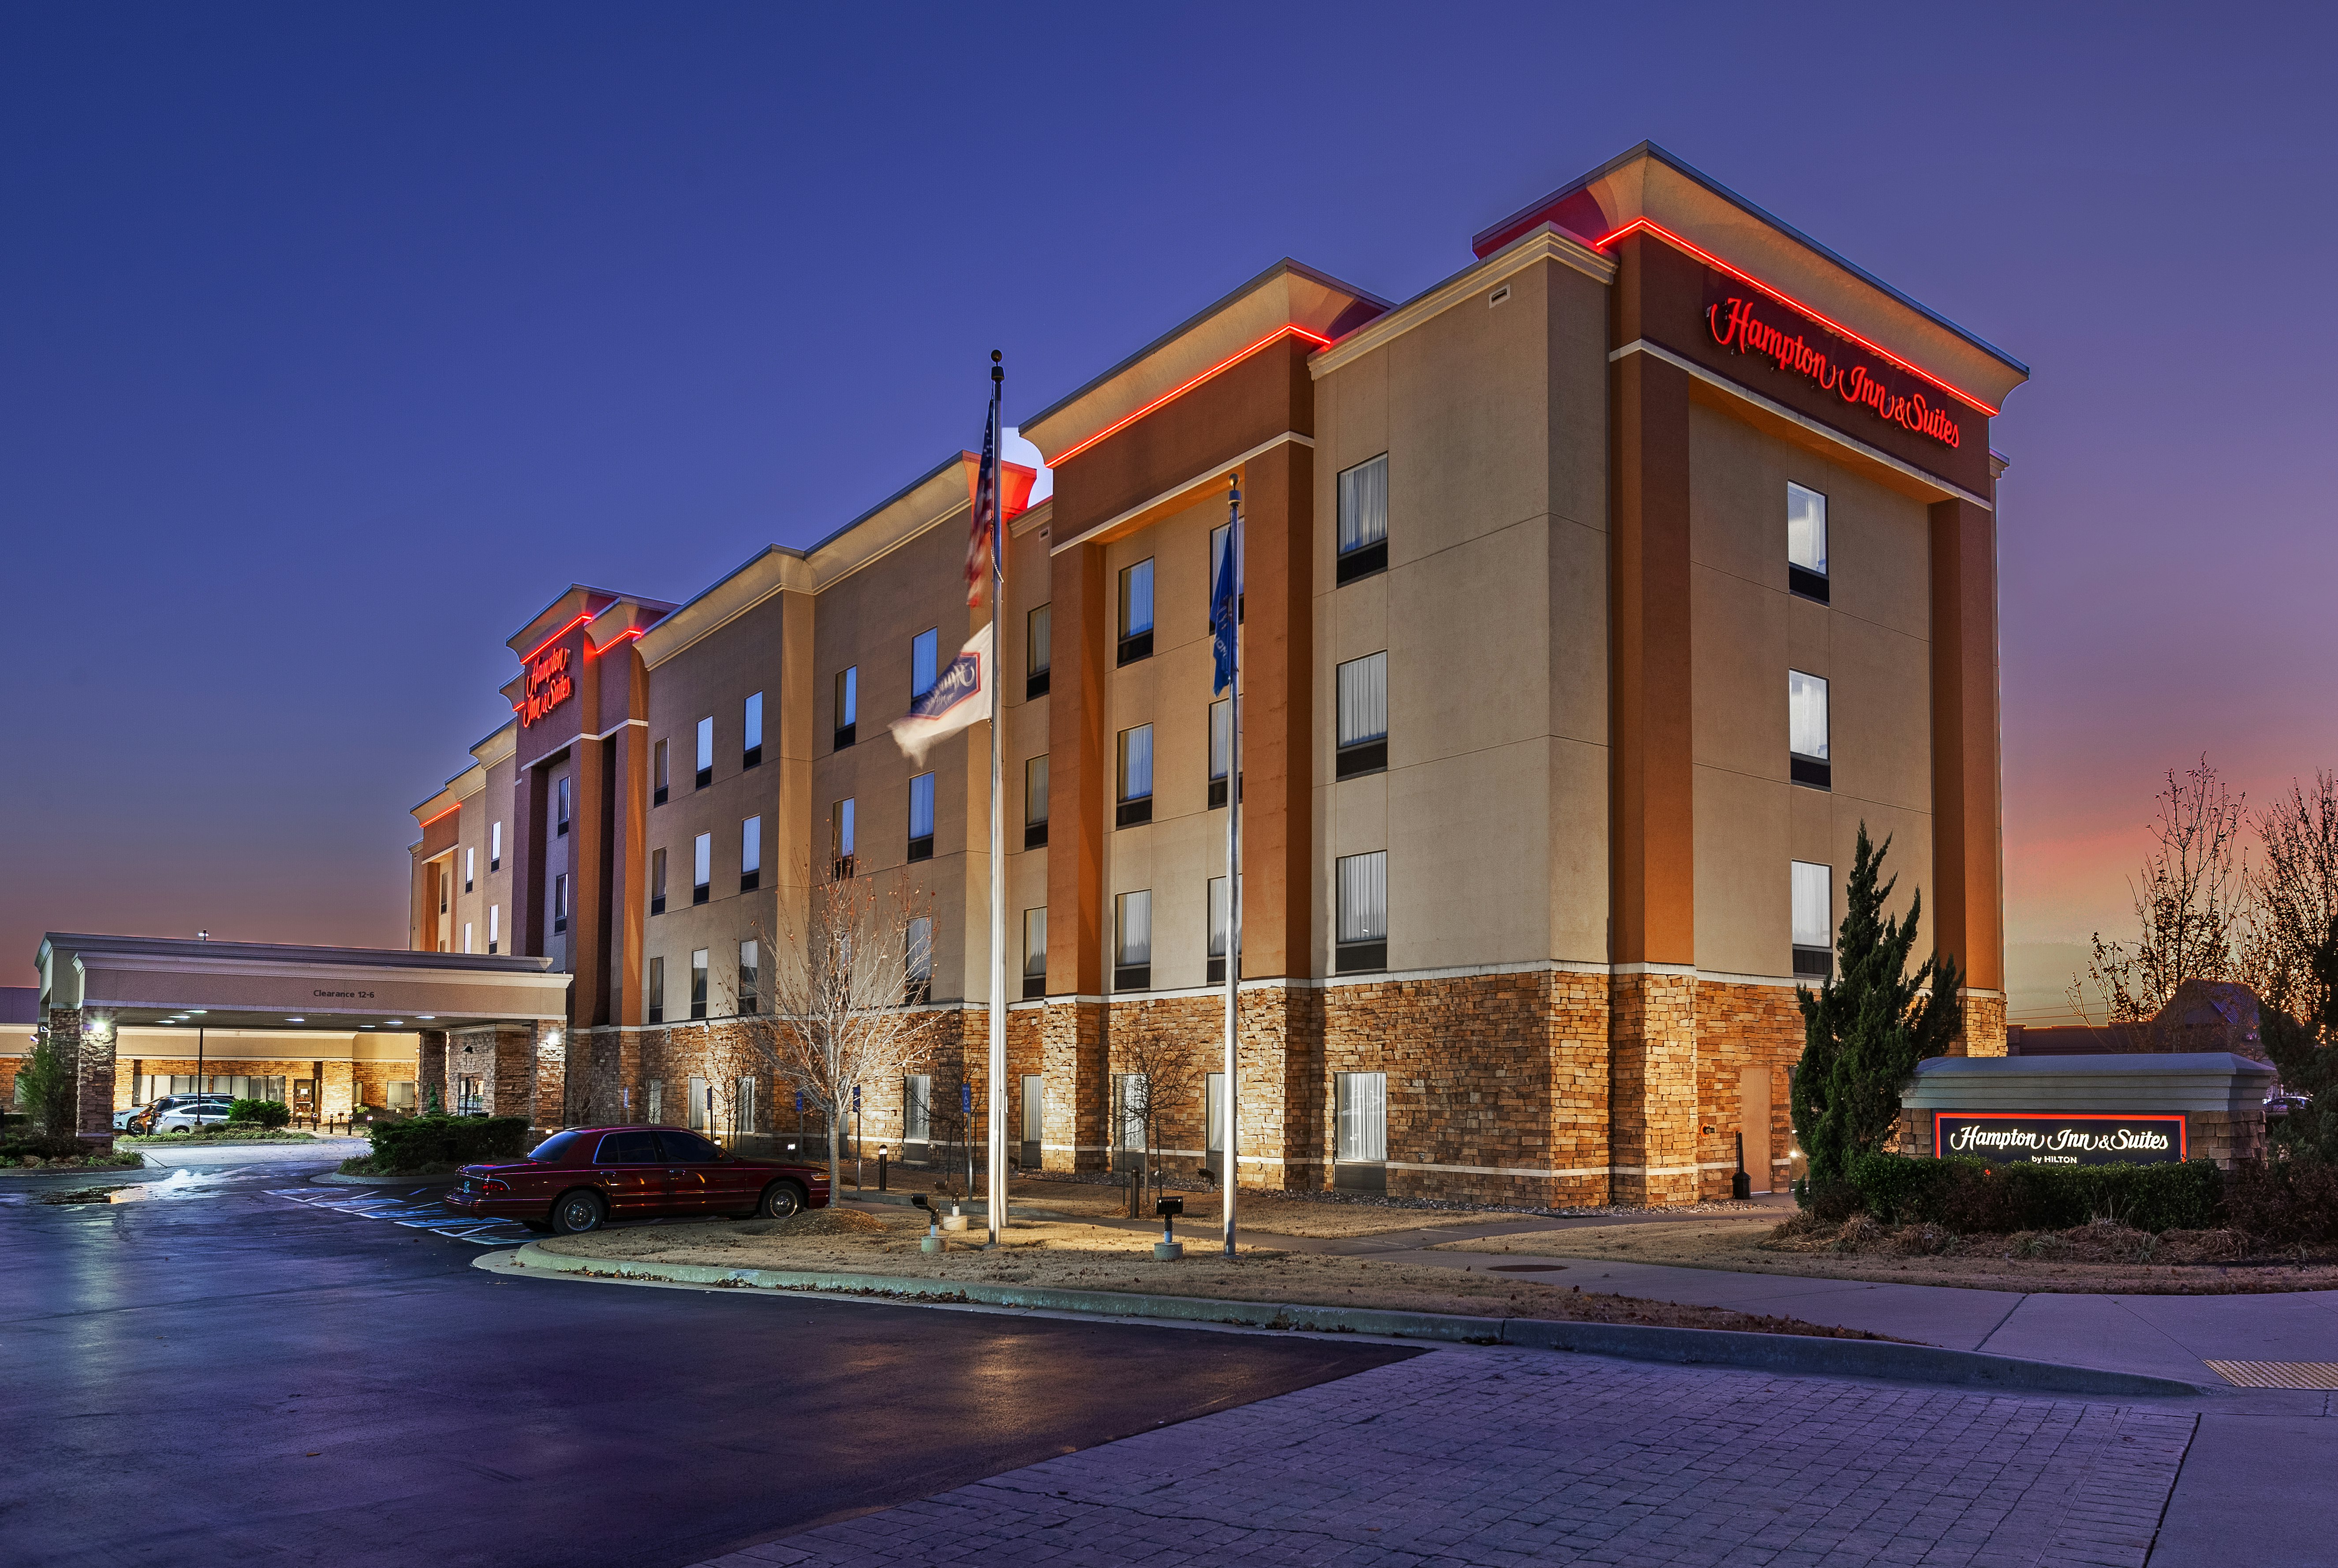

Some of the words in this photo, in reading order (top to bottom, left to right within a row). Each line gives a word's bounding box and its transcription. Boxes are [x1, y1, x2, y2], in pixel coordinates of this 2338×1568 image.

[1711, 298, 1836, 389] Hampton
[1839, 366, 1895, 418] Inn
[1895, 396, 1908, 429] &
[1906, 393, 1959, 448] Suites
[527, 647, 568, 698] Hampton
[547, 674, 570, 709] Suites
[314, 989, 355, 998] Clearance
[1950, 1125, 2045, 1150] Hampton
[2047, 1129, 2099, 1151] Inn
[2098, 1135, 2113, 1151] &
[2110, 1129, 2169, 1150] Suites
[2032, 1155, 2042, 1164] by
